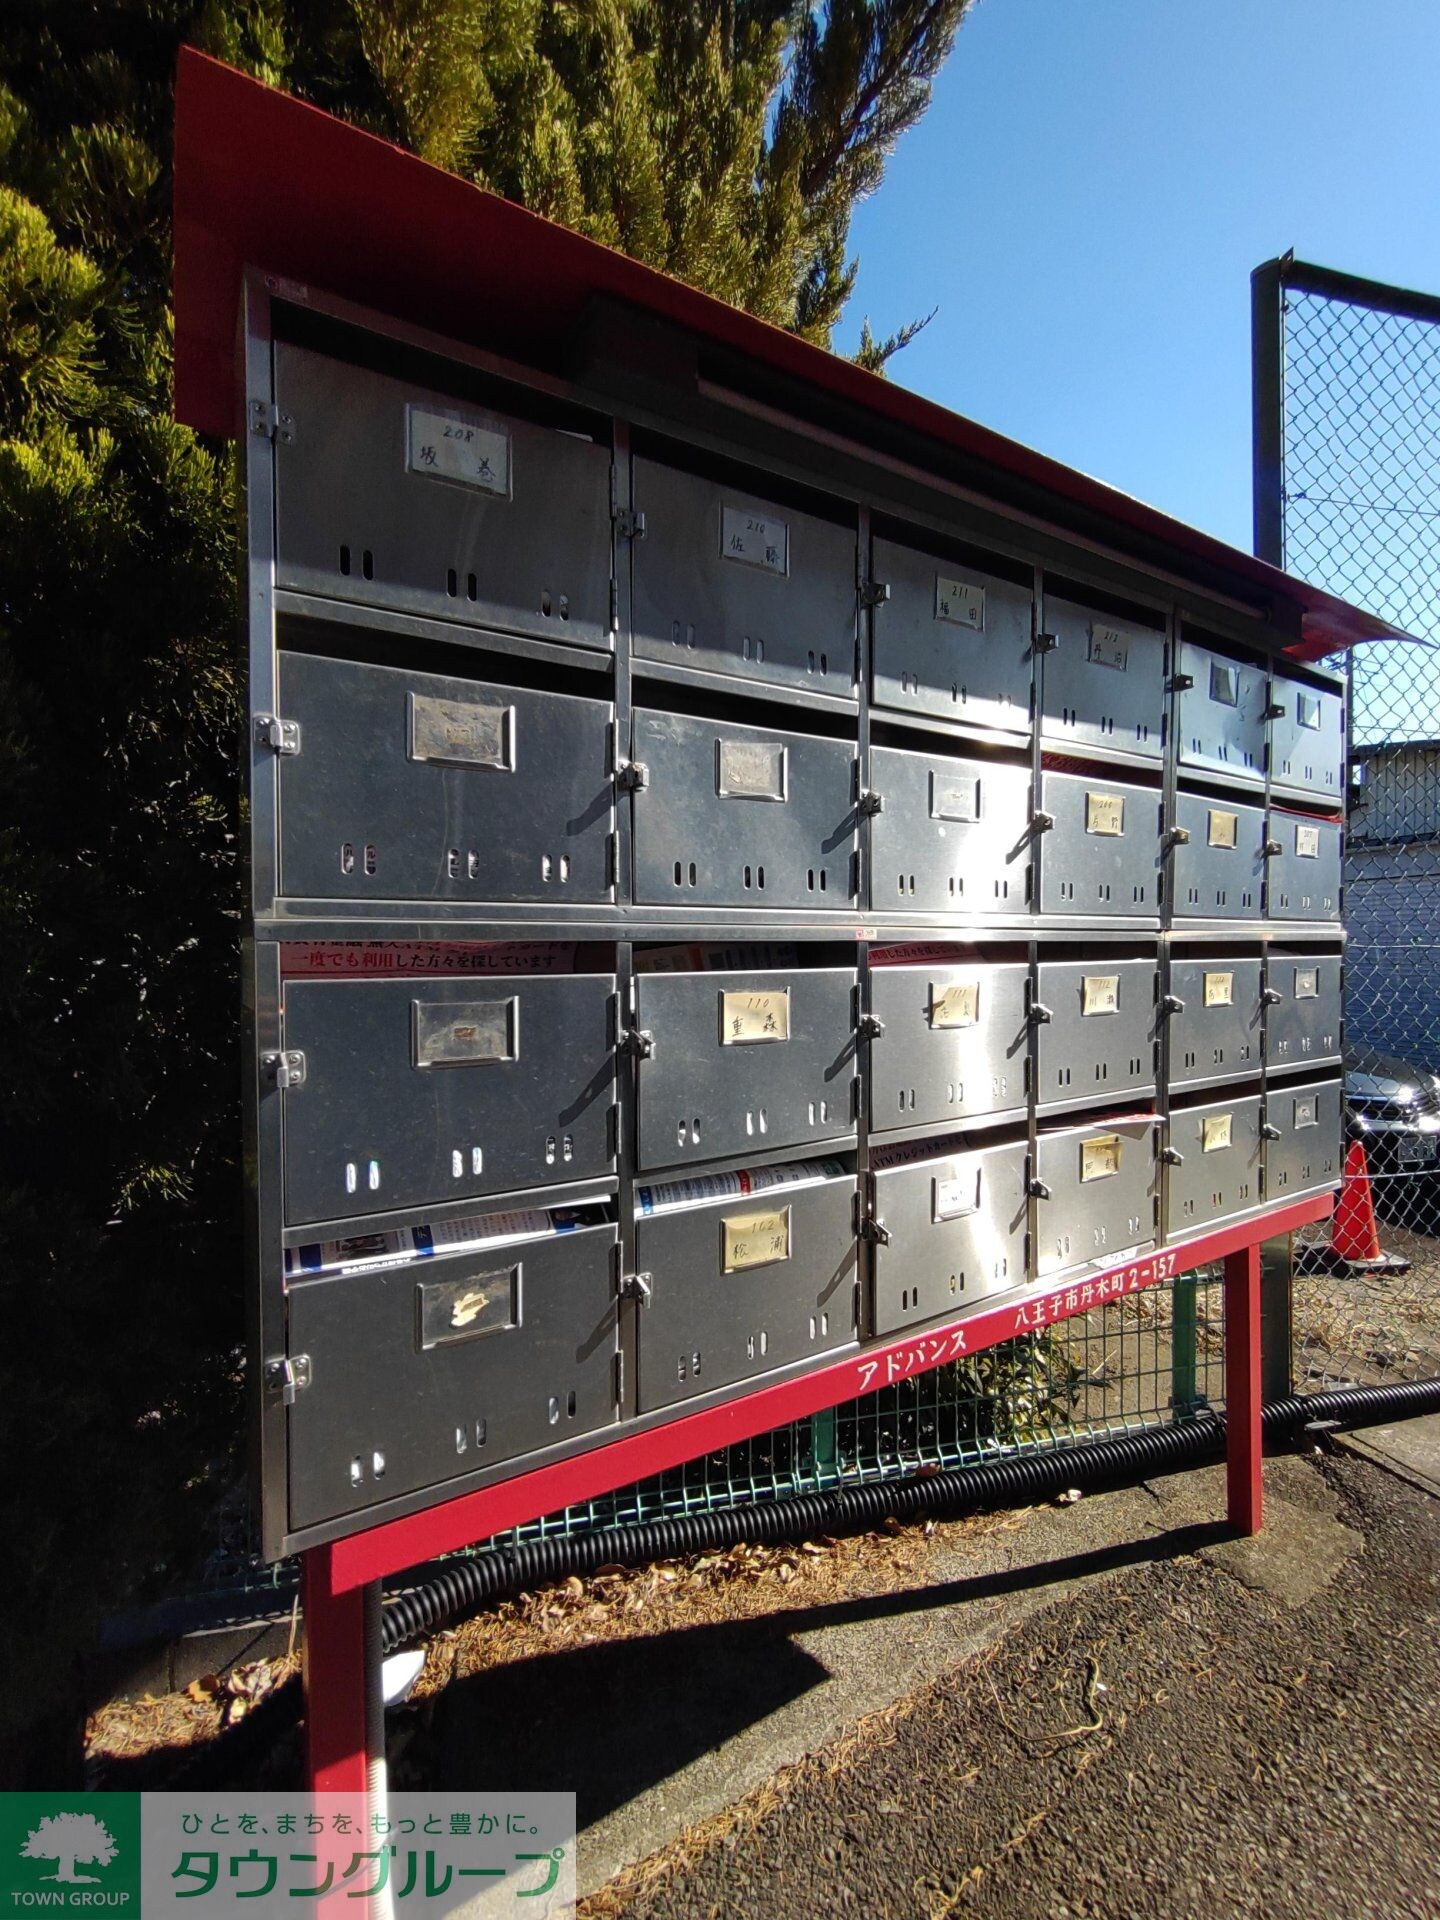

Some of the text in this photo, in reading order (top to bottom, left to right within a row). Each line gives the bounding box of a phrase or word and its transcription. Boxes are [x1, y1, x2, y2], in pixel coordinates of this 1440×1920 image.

[443, 425, 475, 443] 208
[746, 519, 765, 534] 210
[952, 585, 968, 599] 211
[292, 951, 556, 968] 一度でも利用した方々を探しています
[747, 997, 769, 1009] 110
[752, 1219, 775, 1234] 102
[856, 1330, 967, 1391] アドバンス
